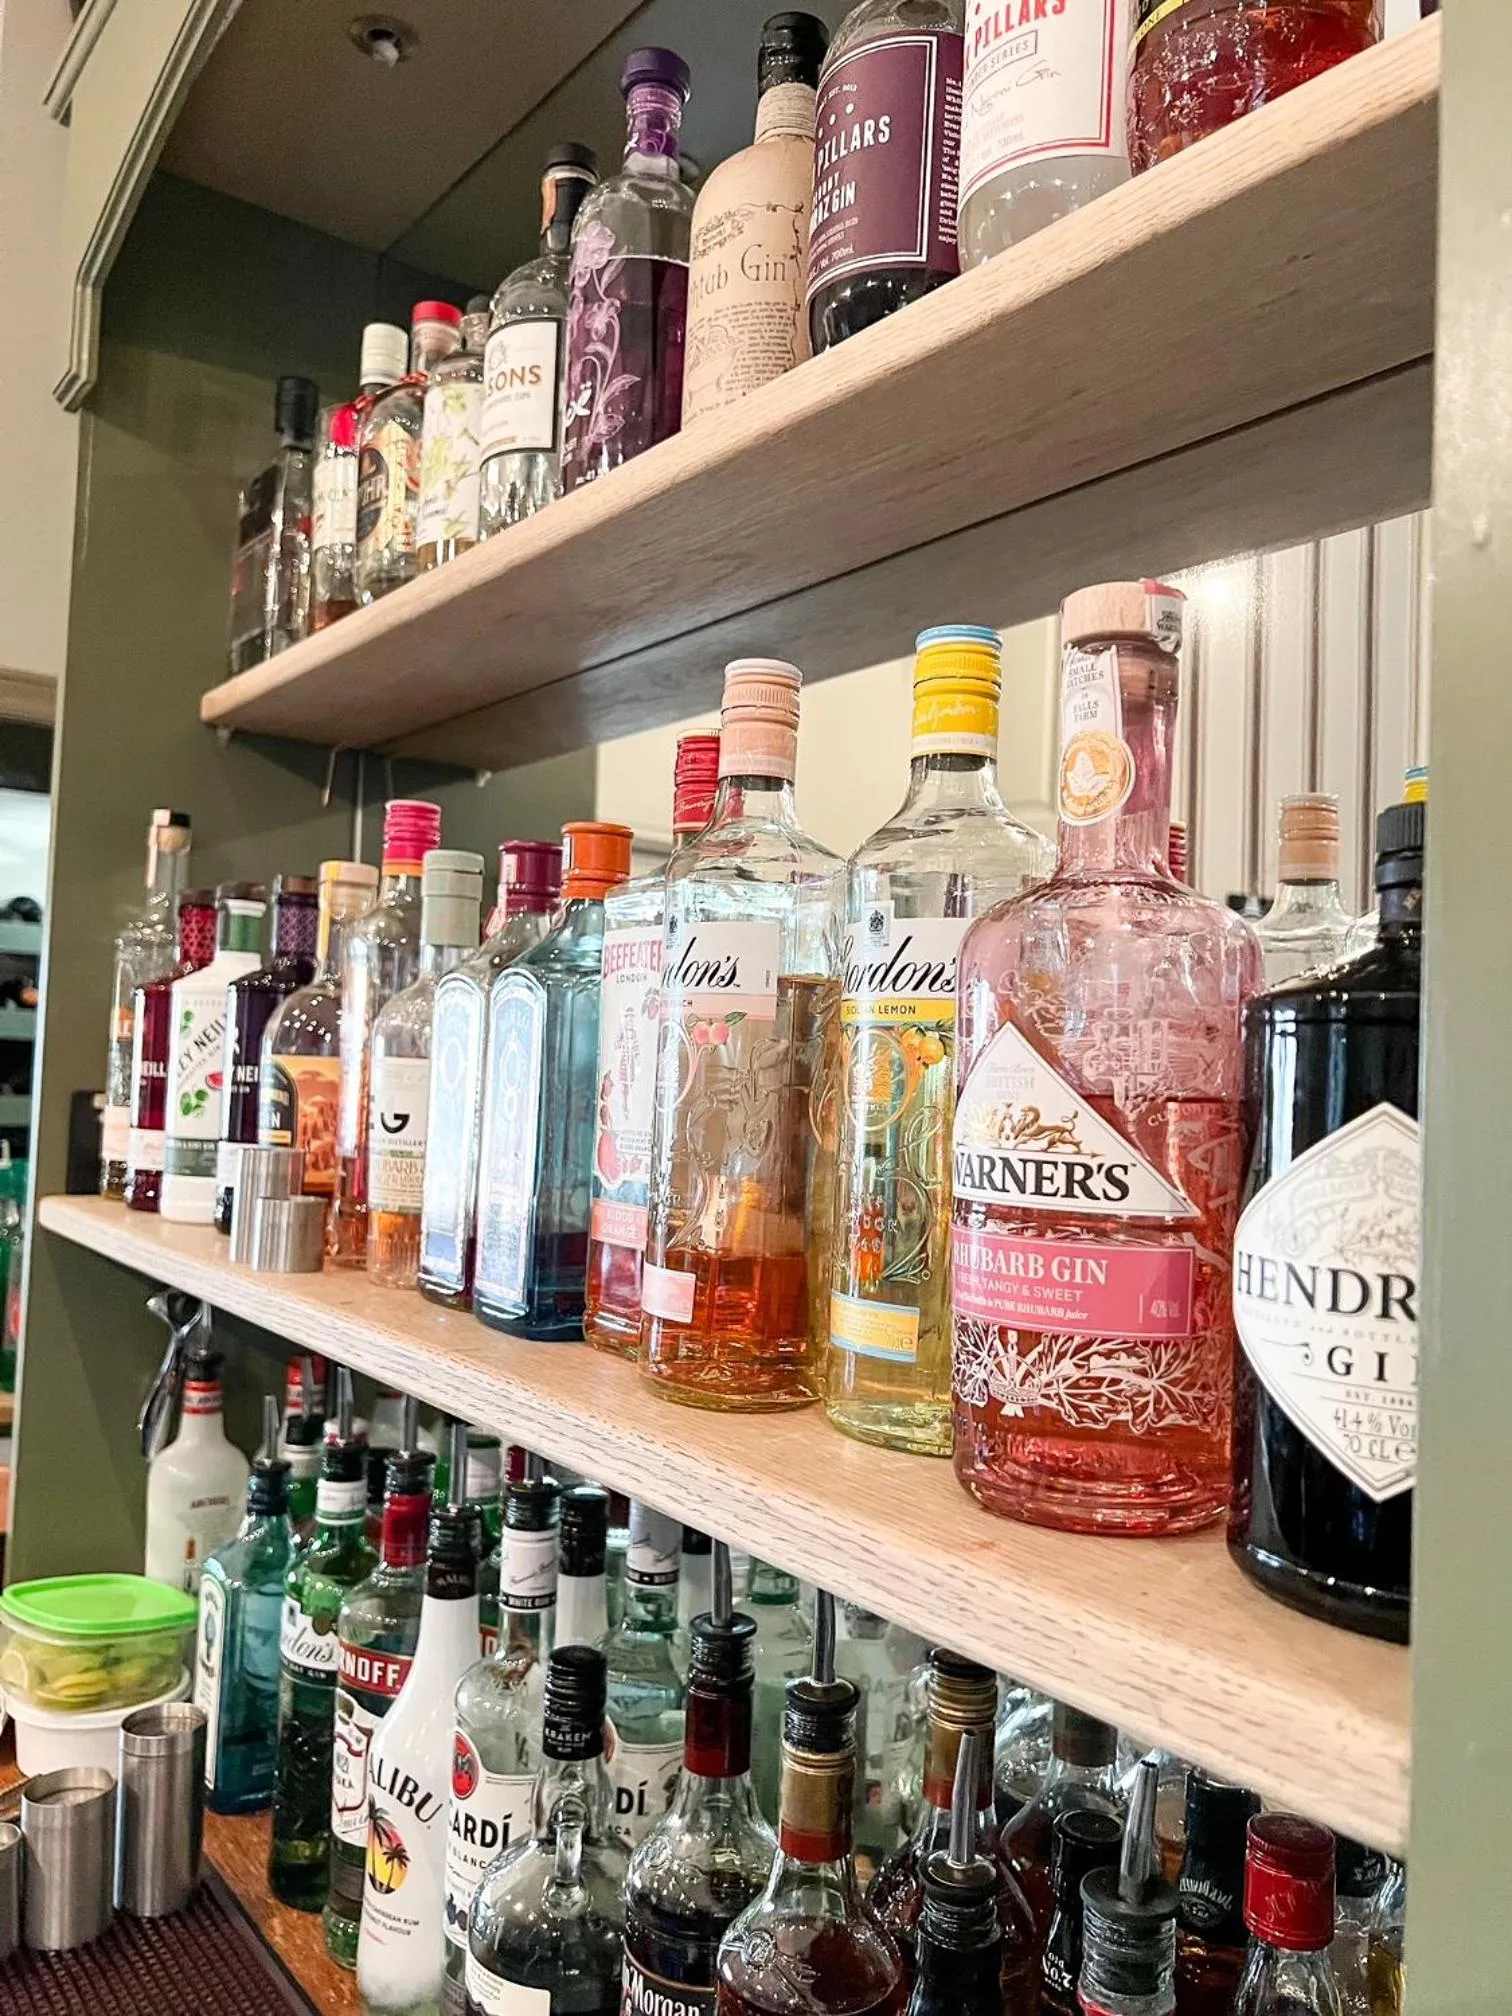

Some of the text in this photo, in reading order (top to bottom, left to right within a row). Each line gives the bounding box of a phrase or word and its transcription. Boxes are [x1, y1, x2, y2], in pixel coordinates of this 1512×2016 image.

[816, 114, 892, 178] PILLARS
[831, 180, 856, 214] GIN
[740, 244, 786, 282] Gin
[878, 1004, 916, 1015] LEMON
[236, 1065, 259, 1083] NEI
[1051, 1255, 1108, 1285] GIN
[1236, 1249, 1418, 1322] HENDR
[1033, 1286, 1084, 1302] SWEET
[1326, 1344, 1418, 1388] GI
